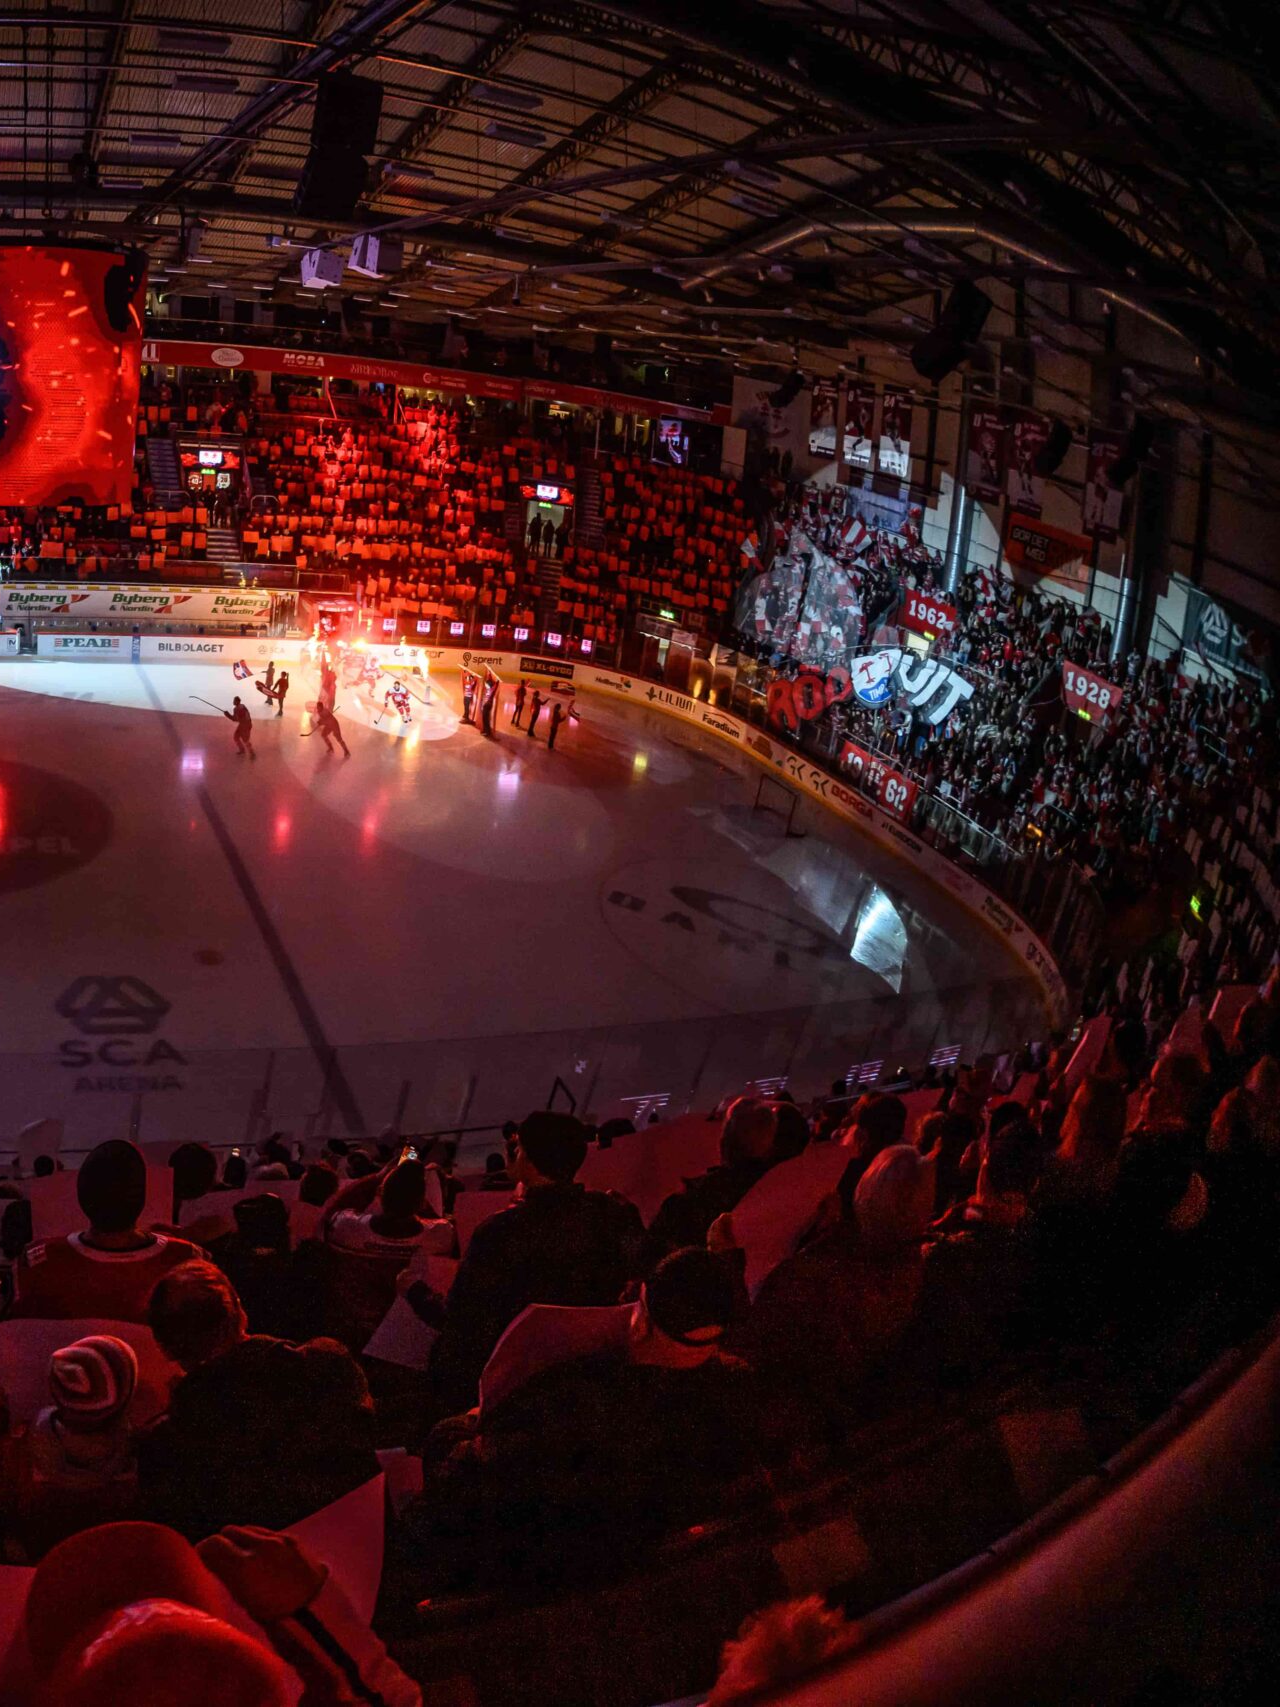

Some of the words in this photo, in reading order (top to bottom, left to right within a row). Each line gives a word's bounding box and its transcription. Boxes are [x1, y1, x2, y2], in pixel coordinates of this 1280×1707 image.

[283, 353, 325, 367] MOBA
[7, 592, 67, 605] Byberg
[112, 593, 170, 606] Byberg
[214, 596, 270, 608] Byberg
[222, 607, 254, 615] Nordin
[908, 599, 947, 630] 1962
[62, 638, 113, 648] PEAB
[158, 642, 224, 653] BILBOLAGET
[472, 655, 503, 666] sprent
[898, 654, 975, 726] VIT
[1065, 671, 1111, 710] 1928
[658, 690, 696, 713] LILIUM
[702, 714, 740, 738] Faradium
[831, 784, 874, 822] BORGA
[58, 1038, 189, 1068] SCA
[74, 1075, 184, 1093] ARENA
